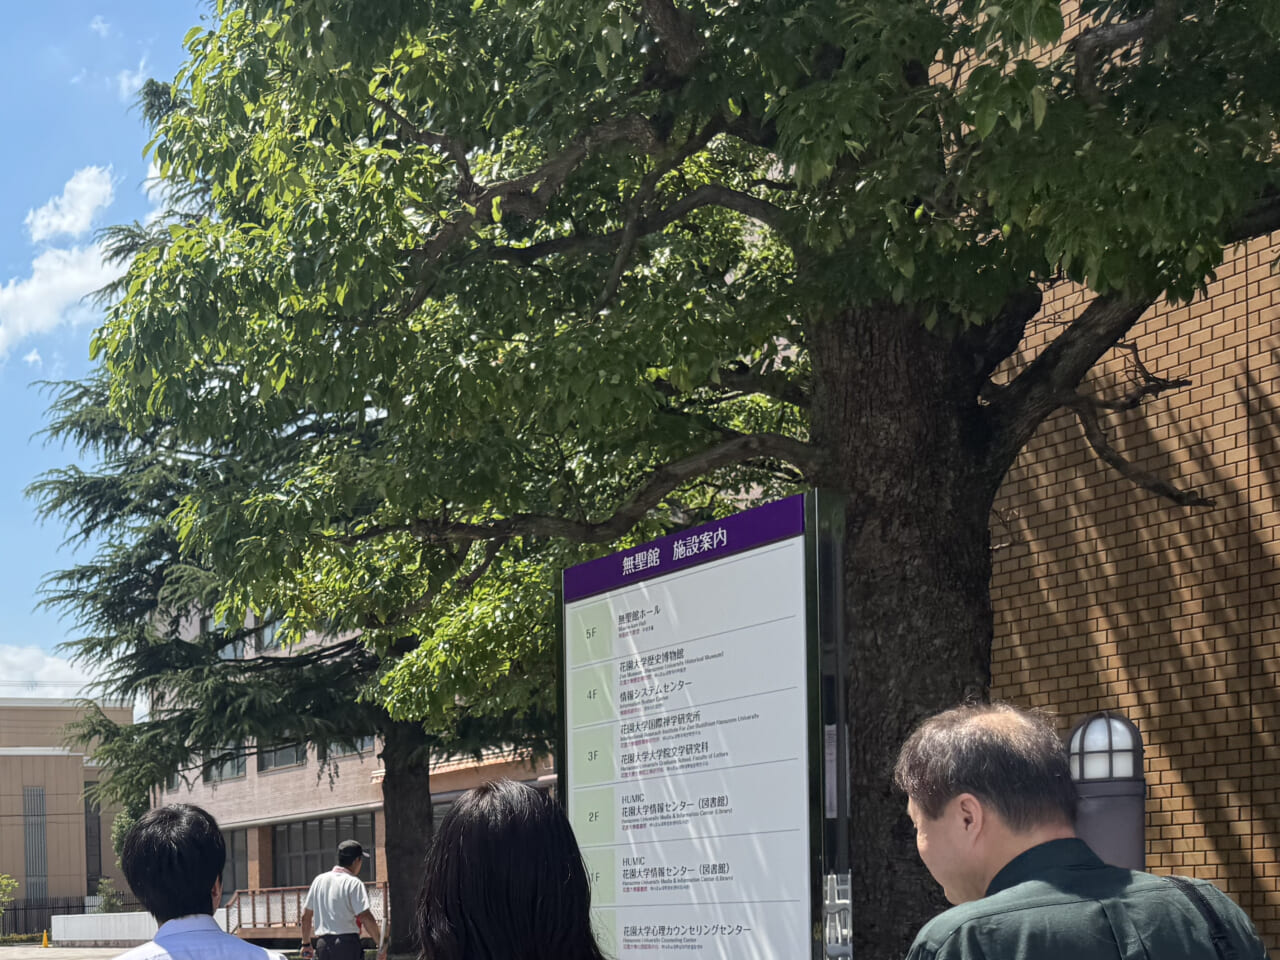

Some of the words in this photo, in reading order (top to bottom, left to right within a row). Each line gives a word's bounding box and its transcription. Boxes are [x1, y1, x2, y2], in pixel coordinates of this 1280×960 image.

[622, 547, 660, 576] 無聖館
[672, 527, 727, 561] 施設案内
[618, 605, 661, 626] 無聖館ホール
[586, 626, 597, 639] 5F
[619, 648, 684, 673] 花園大学歴史博物館
[586, 688, 598, 700] 4F
[619, 680, 693, 703] 情報システムセンター
[620, 710, 701, 735] 花園大学国際禅学研究所
[588, 750, 599, 761] 3F
[620, 740, 709, 765] 花園大学大学院文学研究科
[622, 793, 645, 804] HUMIC
[588, 812, 600, 822] 2F
[622, 856, 646, 866] HUMIC
[623, 924, 752, 937] 花園大学心理カウンセリングセンター
